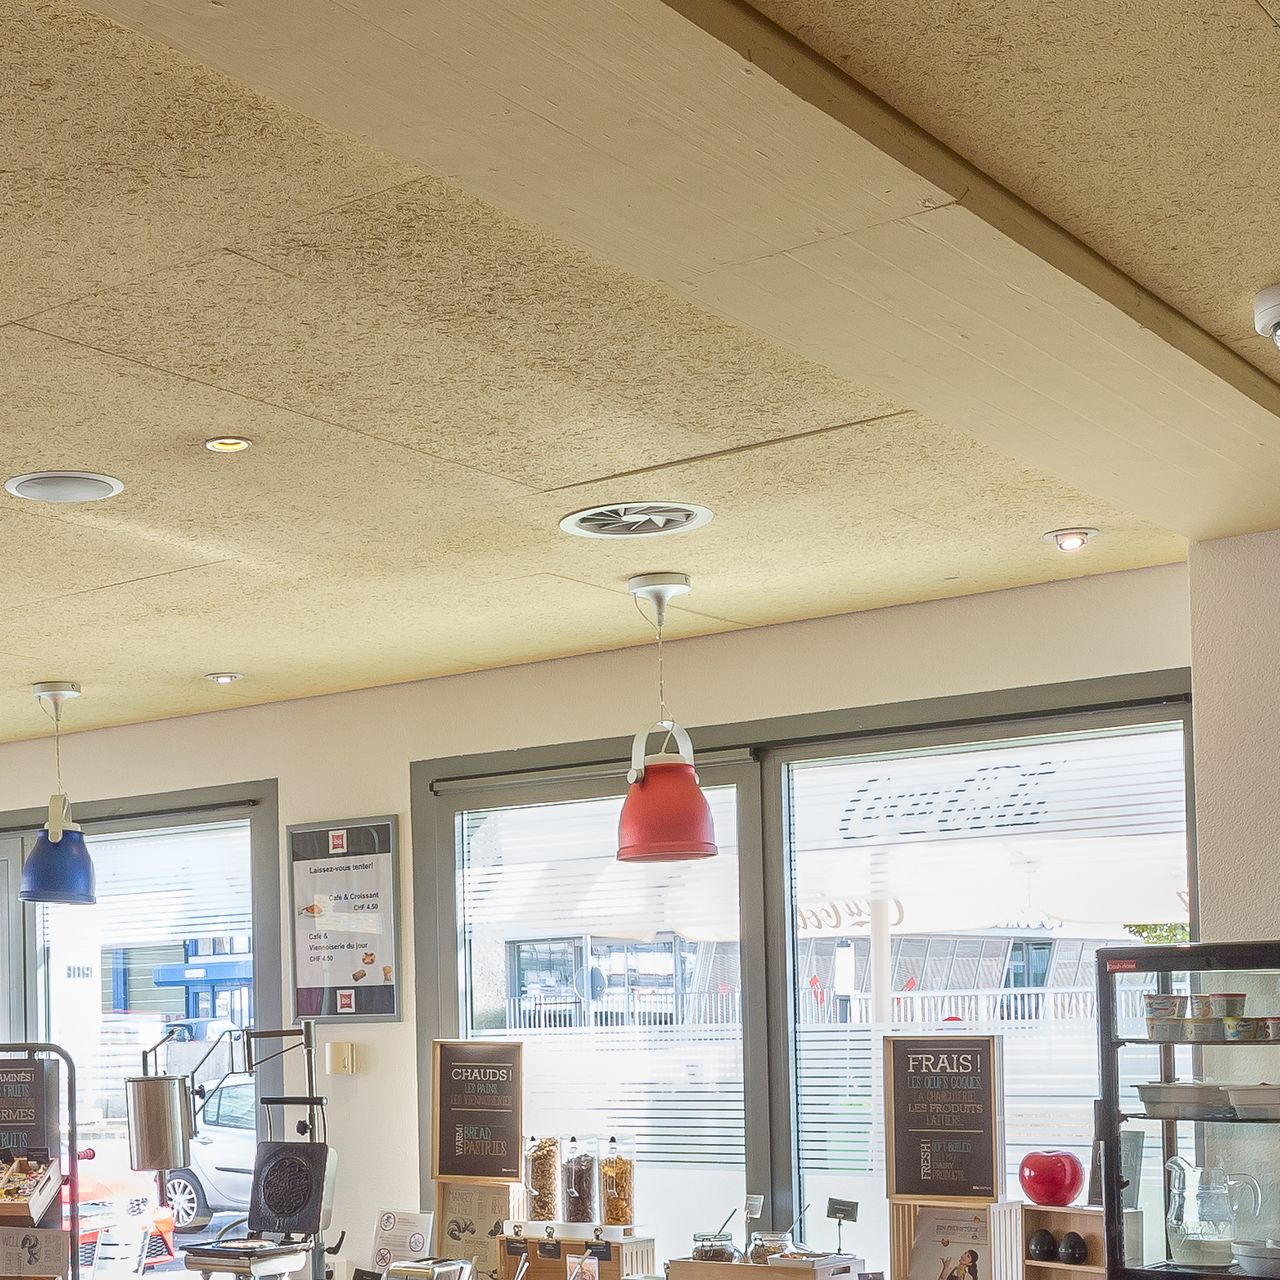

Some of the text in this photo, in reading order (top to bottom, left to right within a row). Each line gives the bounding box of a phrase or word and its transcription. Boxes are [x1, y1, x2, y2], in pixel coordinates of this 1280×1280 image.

[309, 862, 374, 874] Laissez-vous tenter!
[328, 893, 343, 901] Café
[350, 892, 379, 900] Croissant
[309, 943, 345, 951] Viennoiserie
[355, 942, 368, 950] jour
[908, 1103, 983, 1114] LES PRODUITS
[464, 1126, 492, 1140] BREAD
[464, 1140, 507, 1156] PASTRIES
